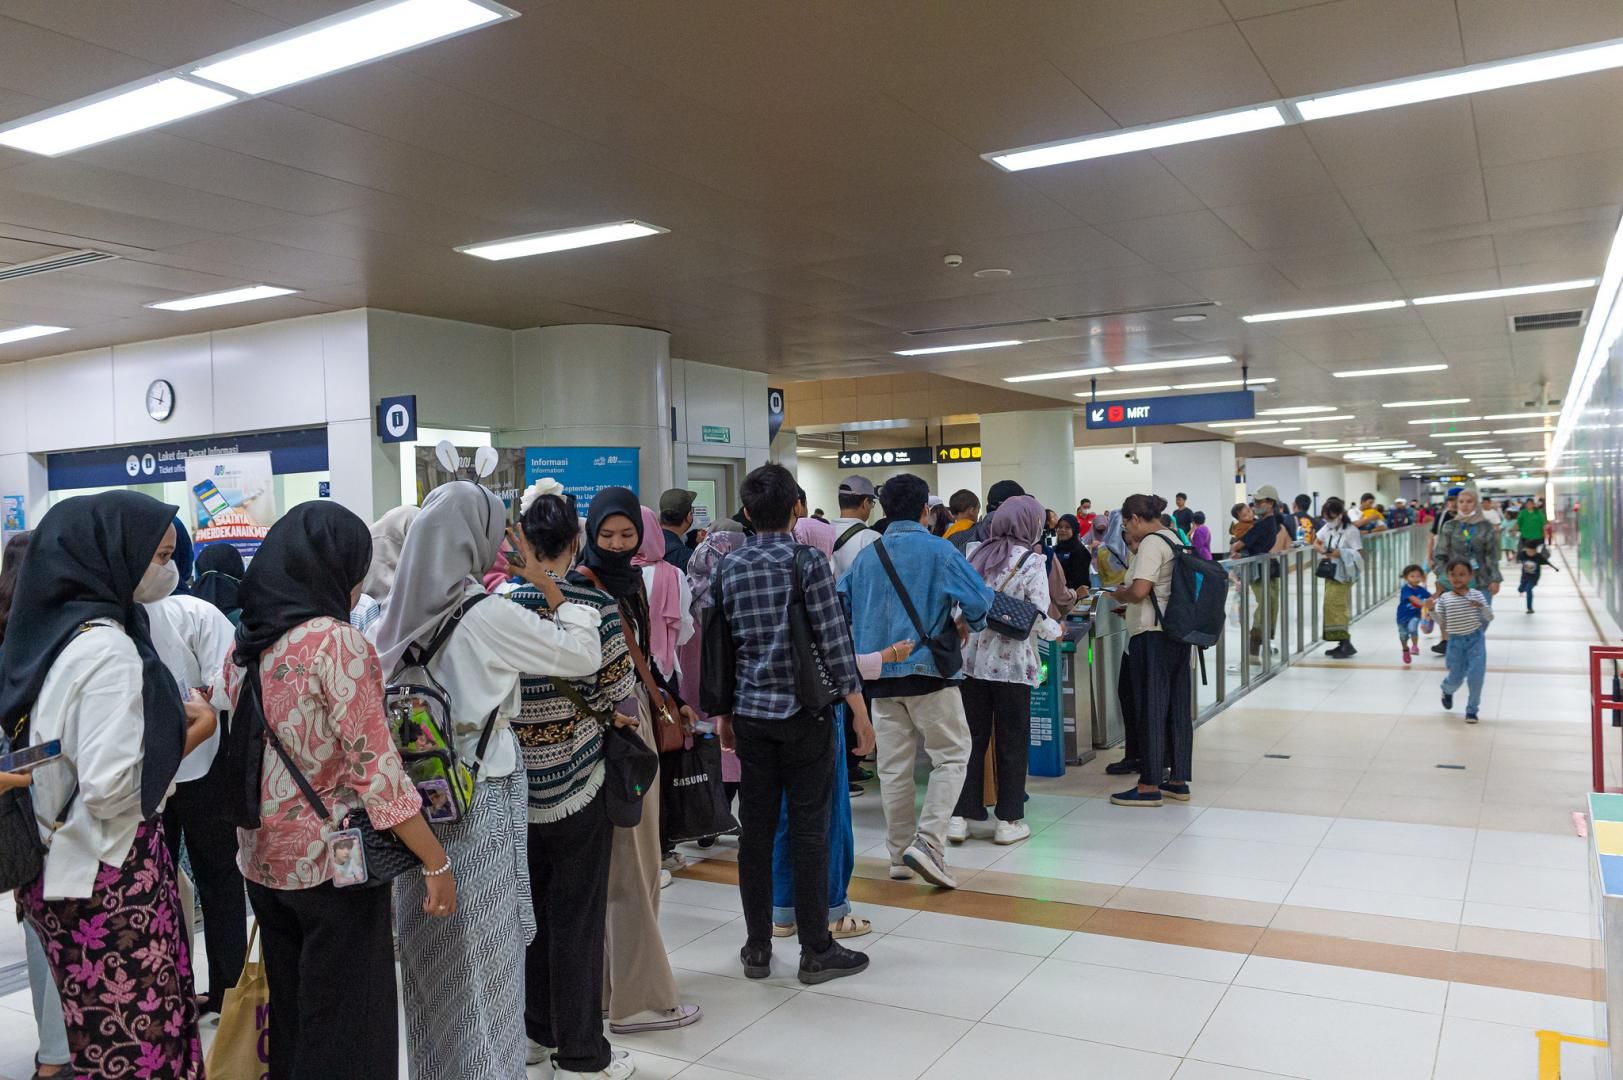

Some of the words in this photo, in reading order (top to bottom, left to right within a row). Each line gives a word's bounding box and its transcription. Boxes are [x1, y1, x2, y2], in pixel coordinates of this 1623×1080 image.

[1127, 406, 1151, 419] MRT
[158, 451, 176, 462] Loket
[176, 449, 187, 460] dan
[207, 444, 239, 456] Informasi
[531, 457, 568, 466] Informasi
[159, 465, 174, 474] Ticket
[174, 463, 185, 473] offic
[531, 467, 565, 475] Information
[564, 485, 594, 493] eptember
[196, 525, 271, 542] #MERDEKANAIKMR
[673, 773, 708, 787] SASUNG
